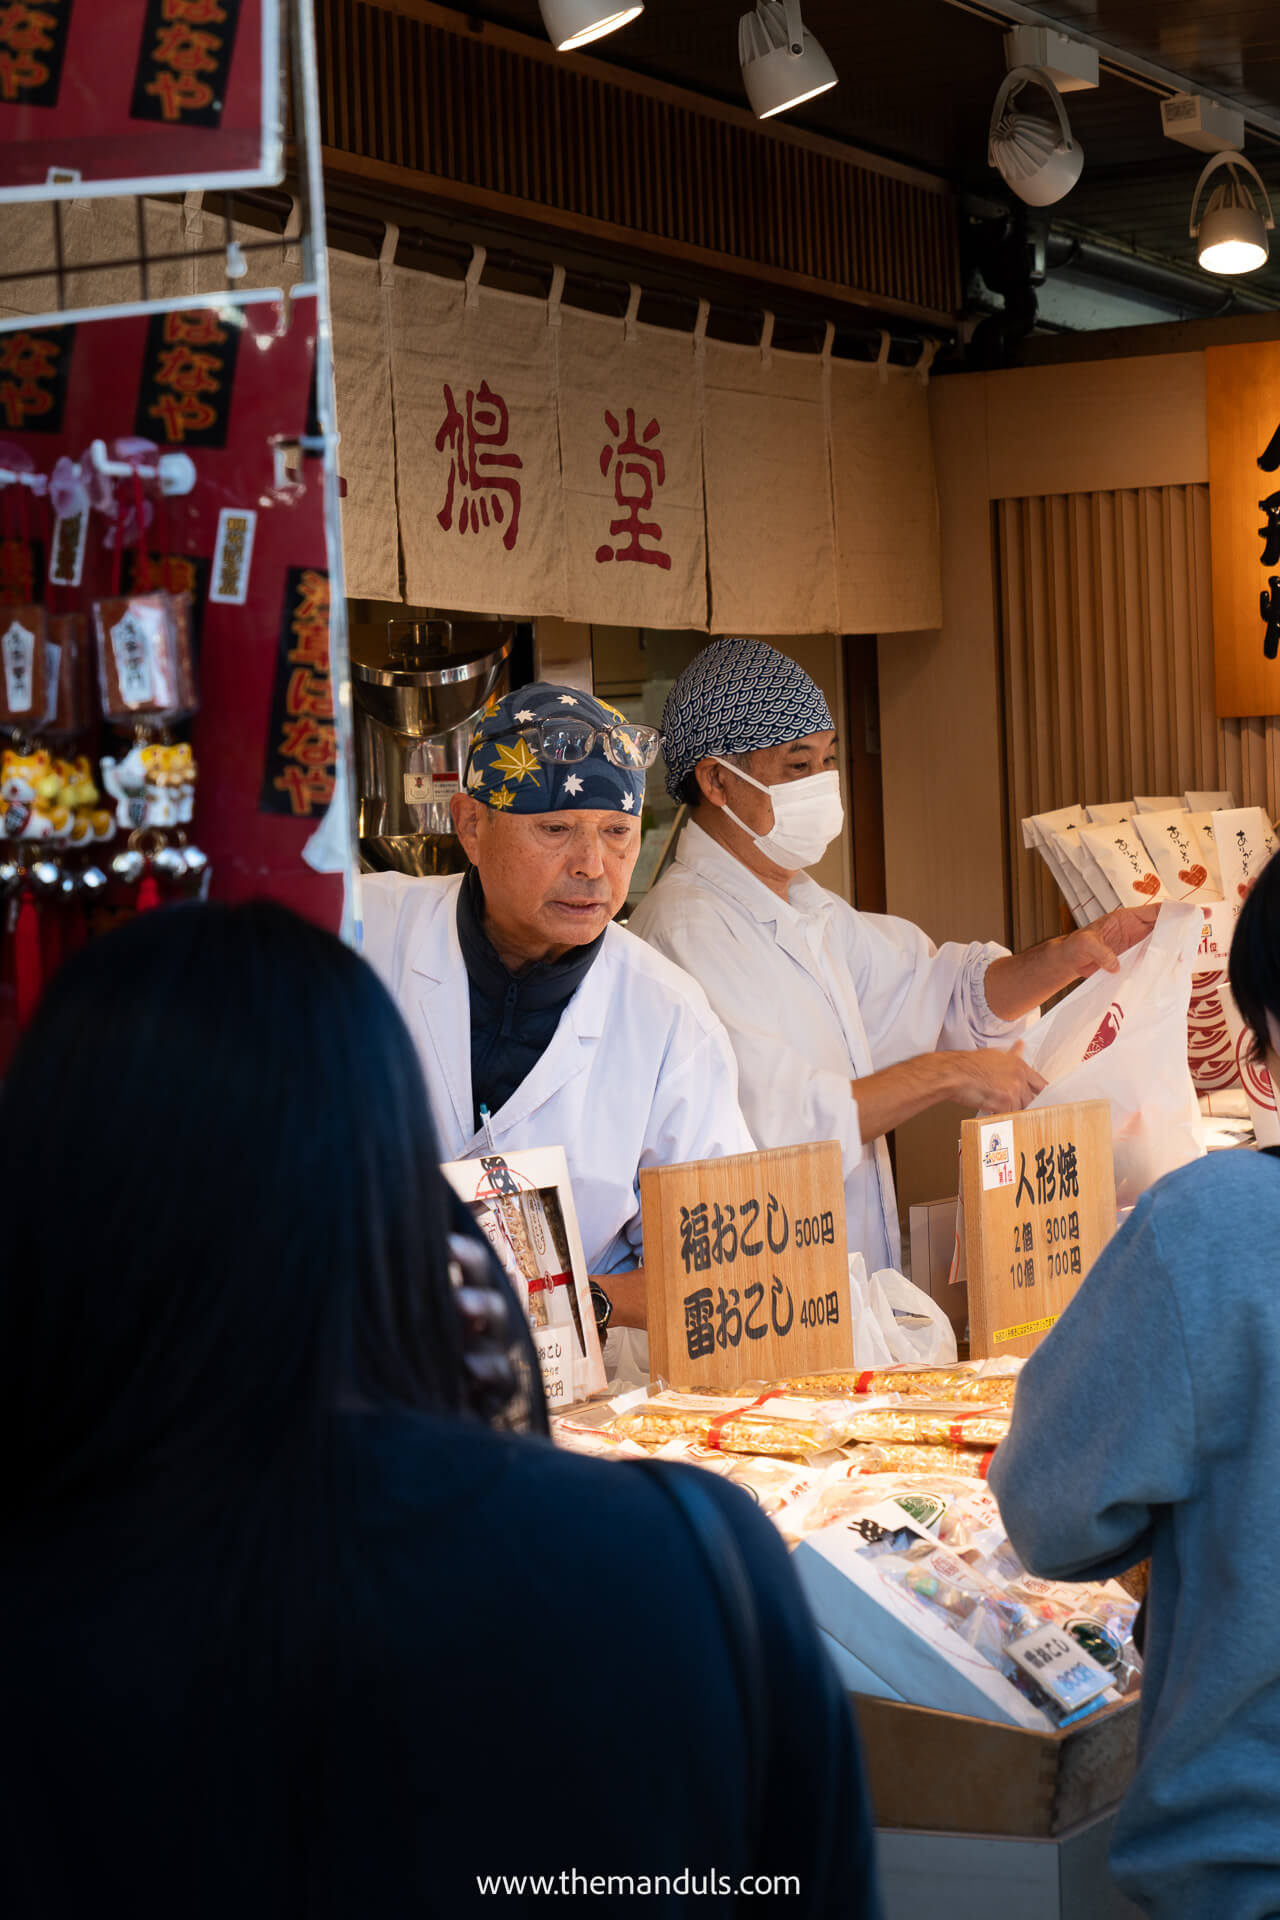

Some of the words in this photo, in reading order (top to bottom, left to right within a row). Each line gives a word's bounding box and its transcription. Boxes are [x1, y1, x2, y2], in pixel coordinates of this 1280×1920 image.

[1015, 1142, 1079, 1208] 人形焼
[680, 1192, 789, 1274] 福おこし
[795, 1211, 835, 1248] 500円
[1013, 1221, 1033, 1253] 2個
[1045, 1210, 1080, 1243] 300円
[1010, 1257, 1035, 1289] 10個
[1047, 1246, 1082, 1279] 700円
[683, 1275, 794, 1360] 雷おこし
[800, 1291, 839, 1328] 400円
